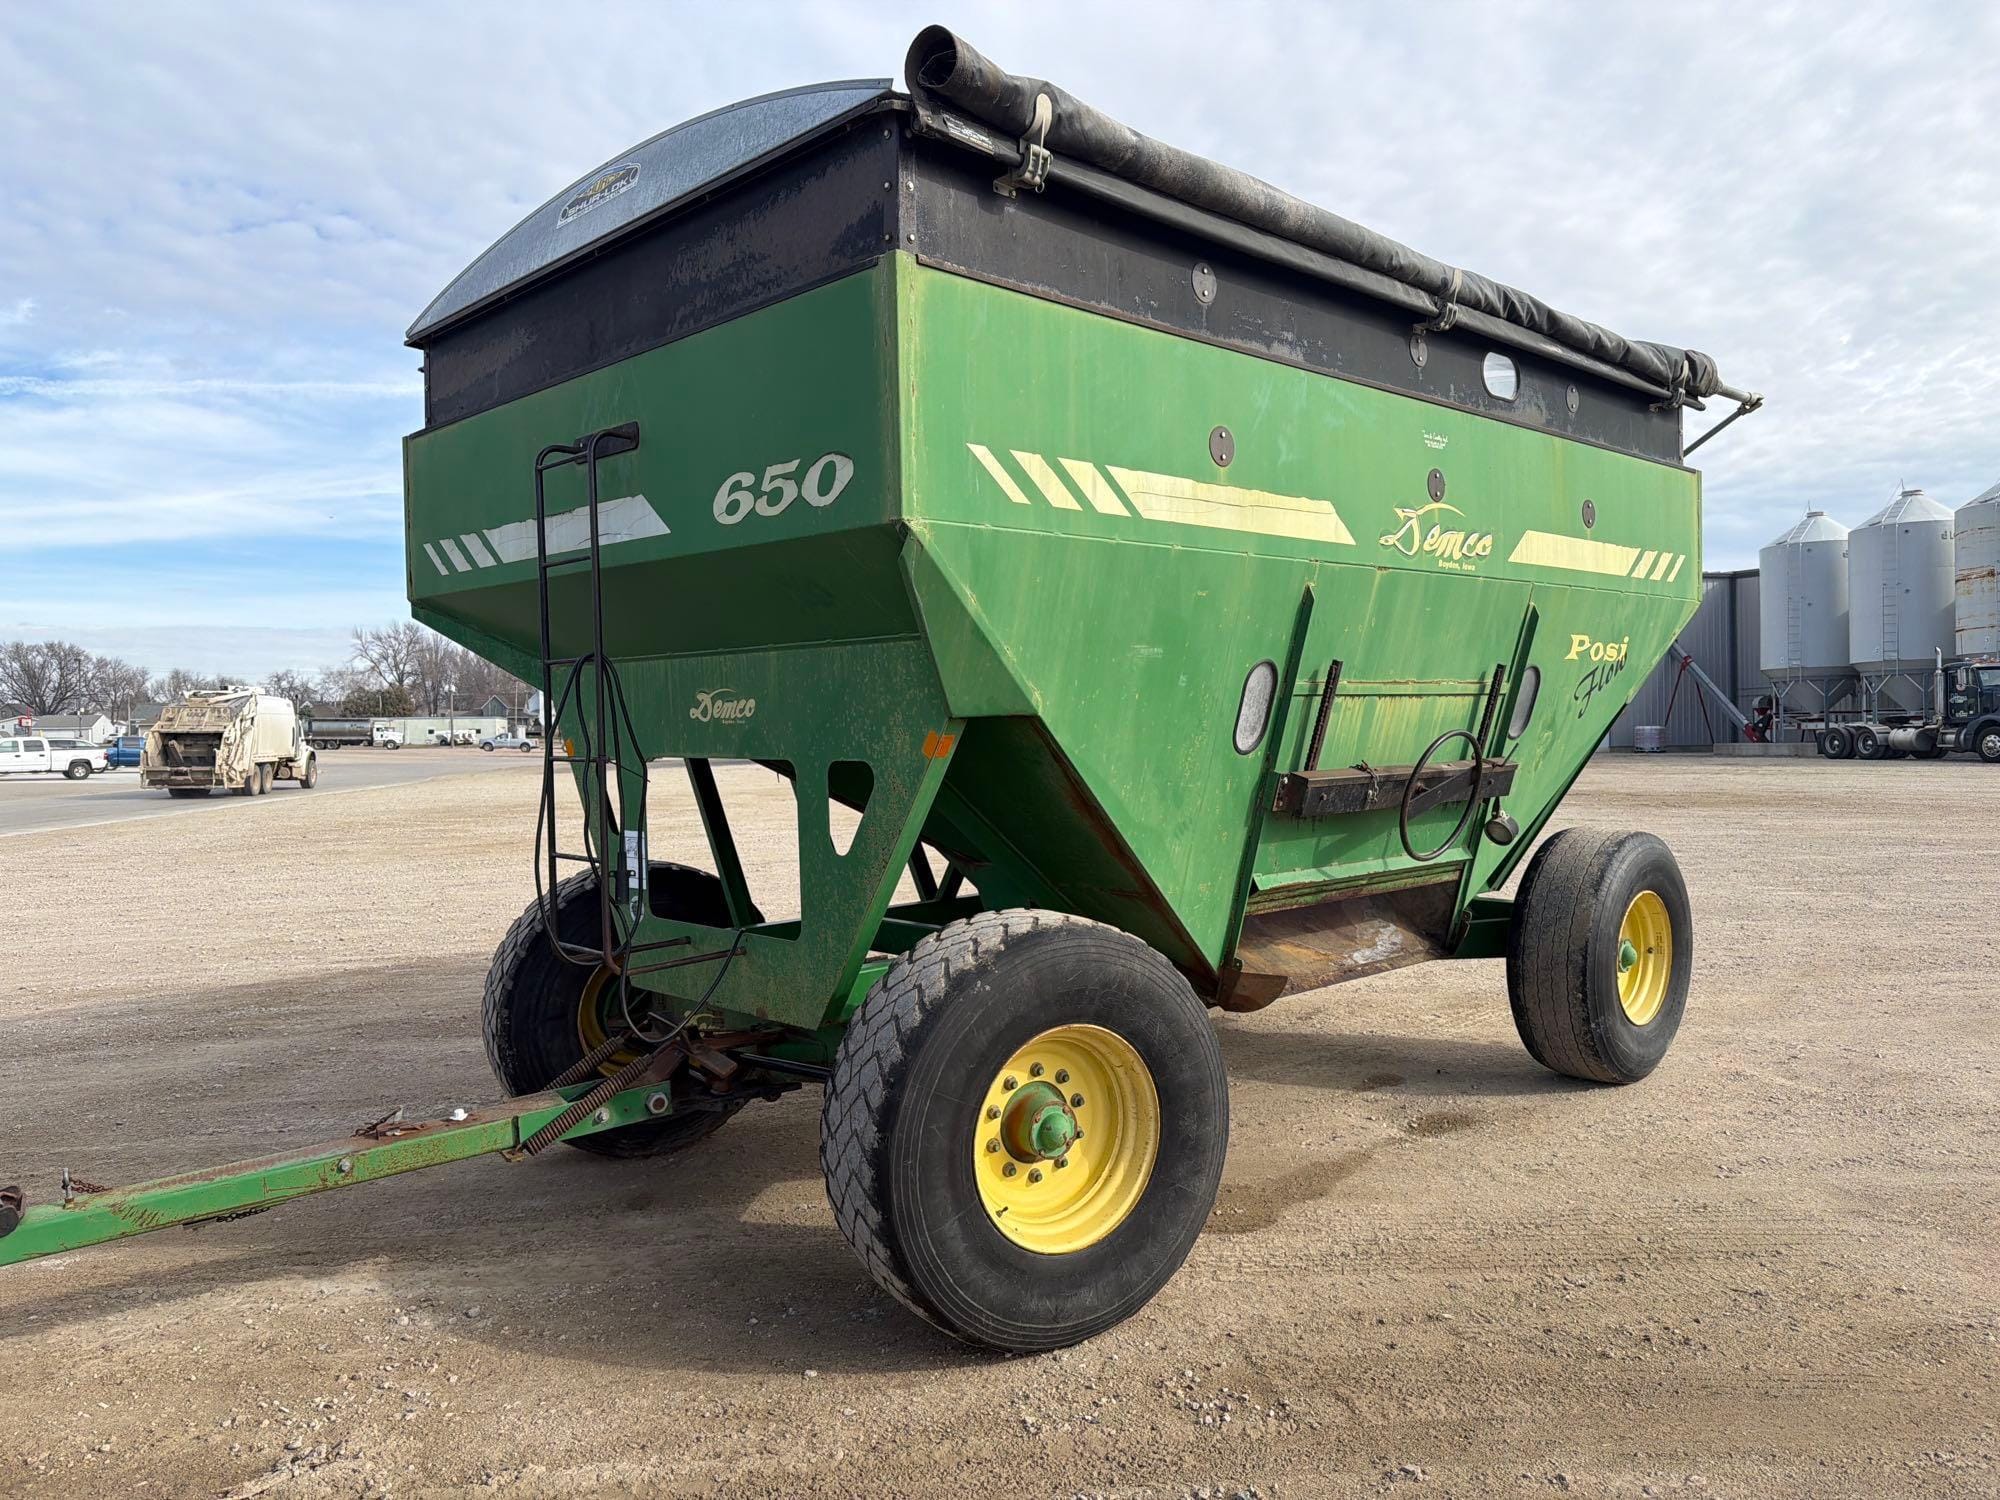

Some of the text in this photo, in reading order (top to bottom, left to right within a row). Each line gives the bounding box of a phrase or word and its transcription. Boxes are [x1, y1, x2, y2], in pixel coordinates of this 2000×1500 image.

[713, 453, 854, 525] 650
[1378, 501, 1493, 560] Demco
[1437, 559, 1476, 571] Boyden, Iowa
[1564, 634, 1630, 662] Posi
[690, 688, 755, 722] Demco
[1573, 651, 1627, 719] Flow
